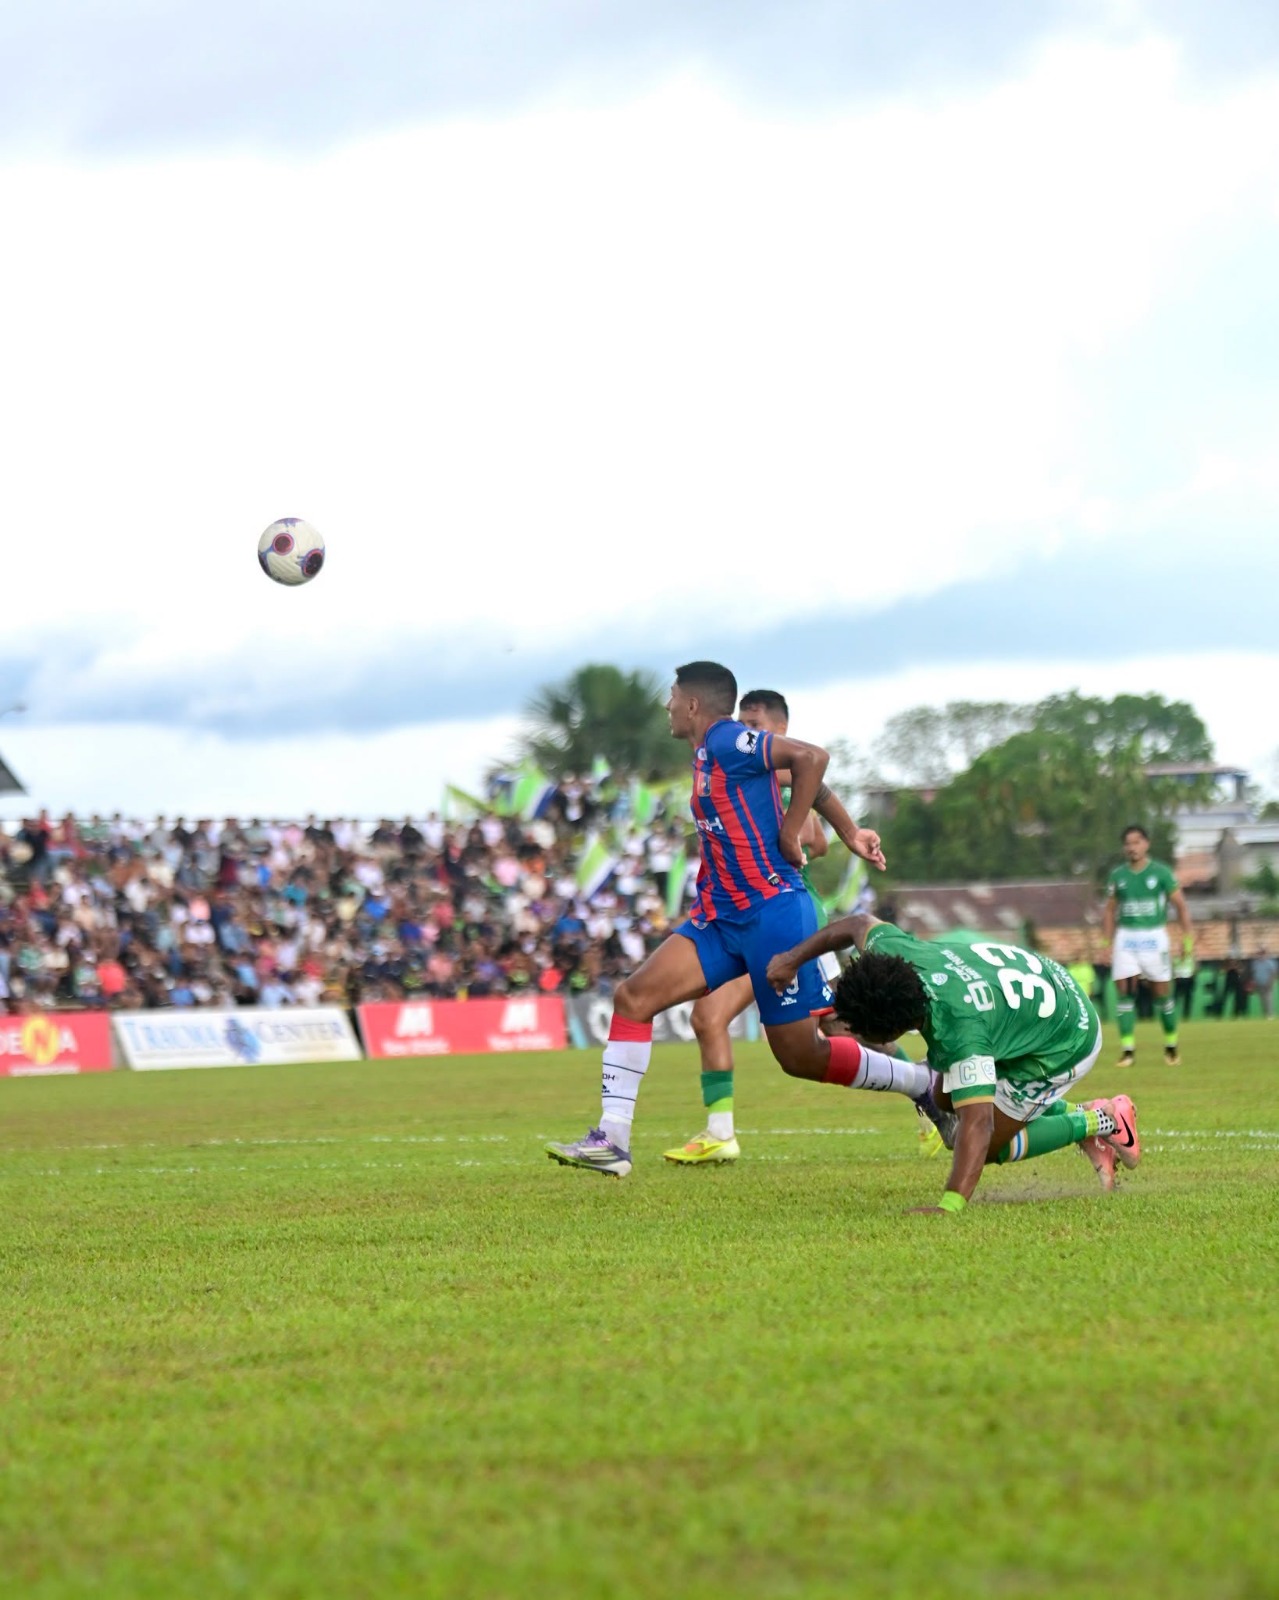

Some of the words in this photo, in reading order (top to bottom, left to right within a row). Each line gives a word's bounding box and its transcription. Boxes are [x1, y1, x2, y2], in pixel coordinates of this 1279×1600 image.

[970, 943, 1056, 1018] 33
[1075, 994, 1089, 1030] New
[959, 1060, 977, 1085] C
